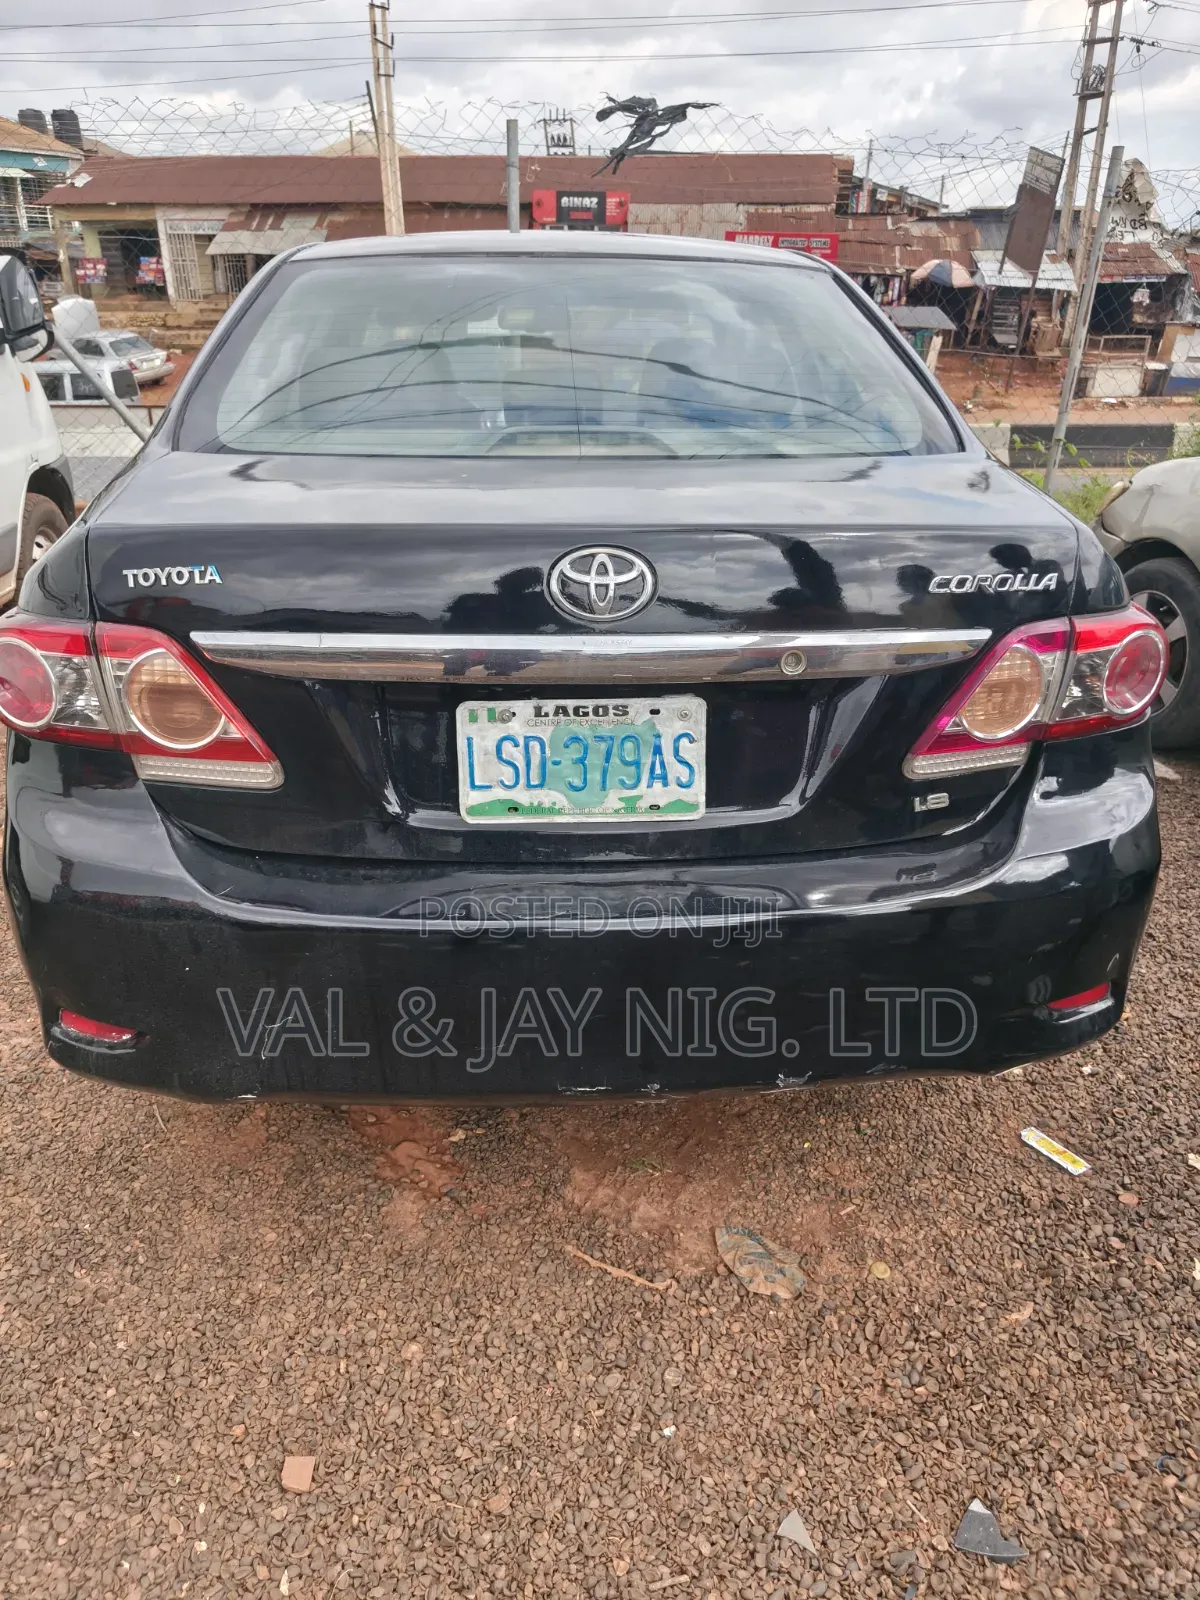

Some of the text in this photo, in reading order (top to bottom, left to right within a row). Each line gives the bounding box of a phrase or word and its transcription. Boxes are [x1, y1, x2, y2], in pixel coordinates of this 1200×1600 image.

[122, 564, 223, 588] TOYOTA
[928, 573, 1059, 594] COROLLA
[533, 704, 630, 718] LAGOS
[526, 718, 562, 727] CENTRE
[564, 718, 577, 727] OF
[466, 732, 697, 792] LSD-379AS
[521, 806, 557, 815] FEDERAL
[914, 793, 949, 812] 1.8
